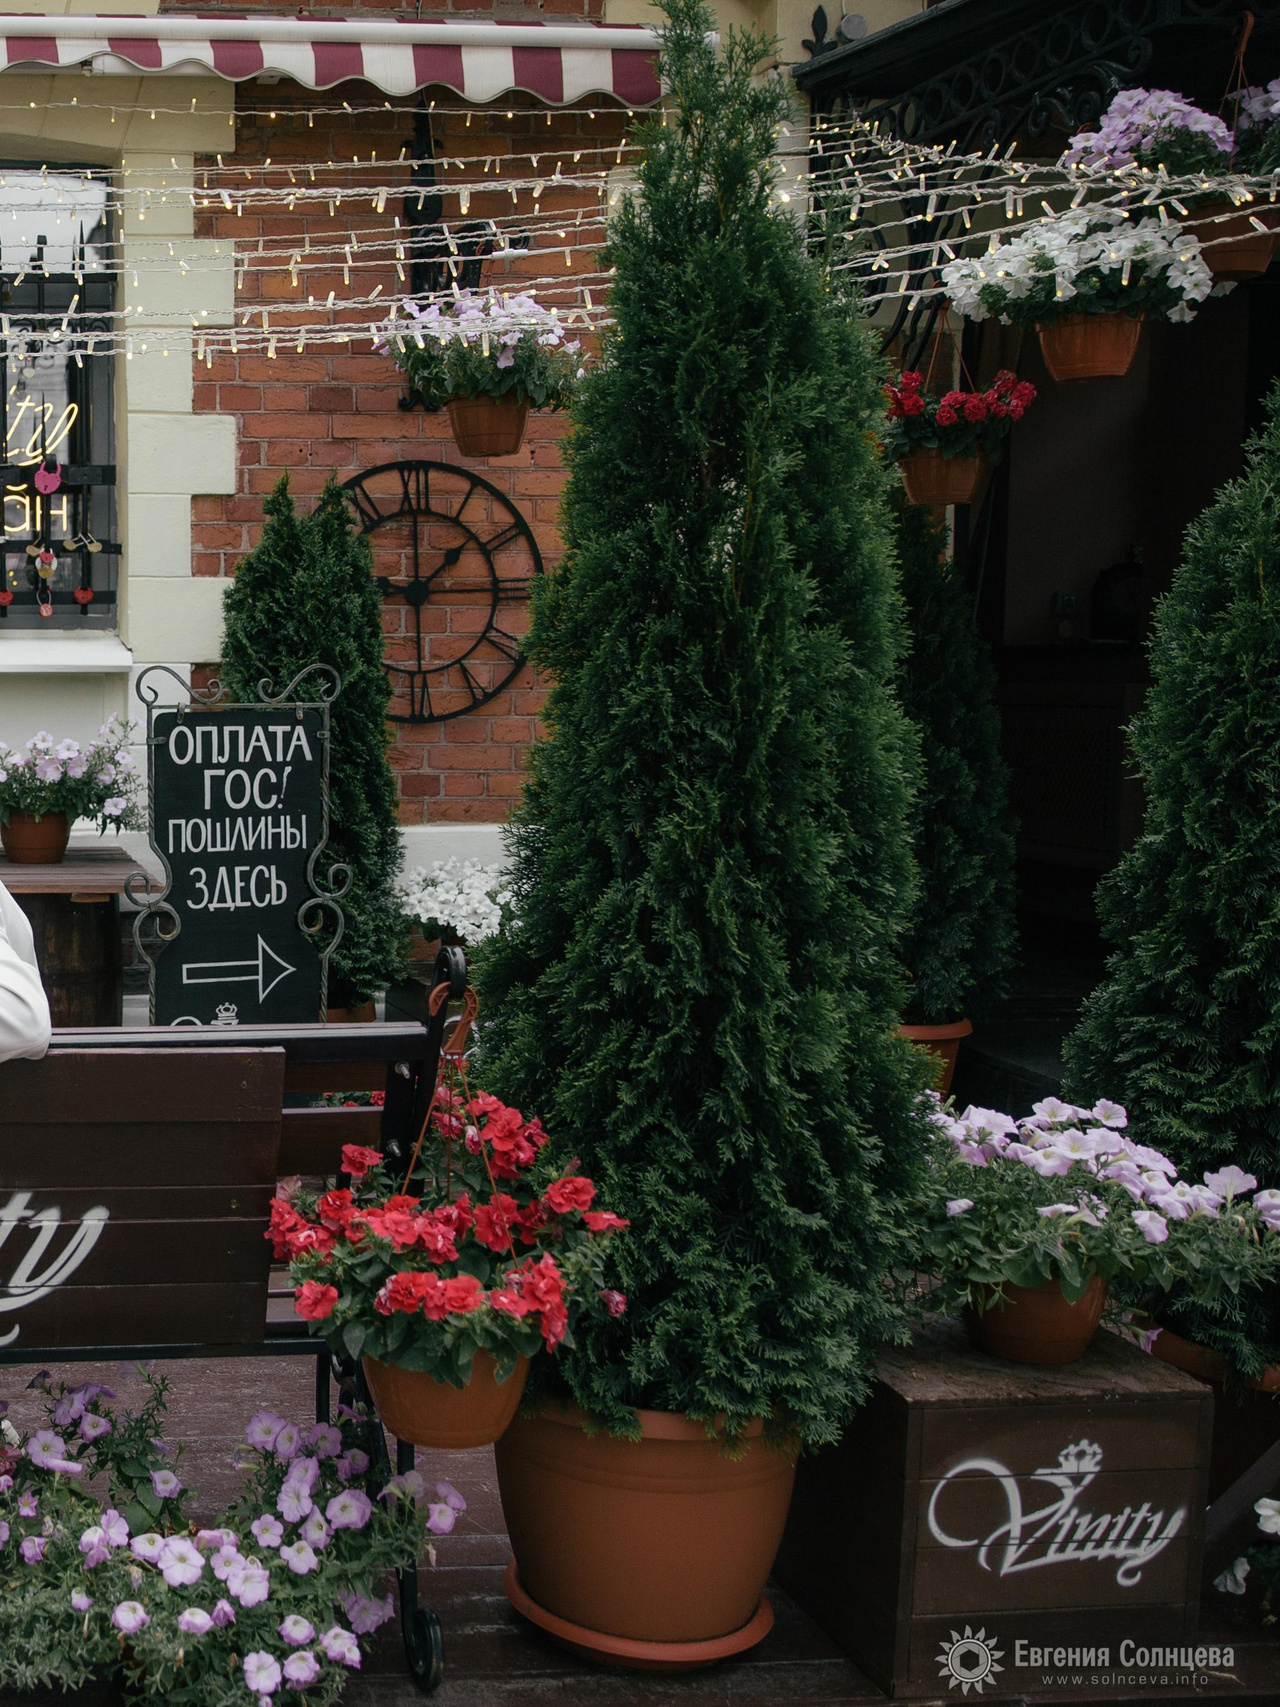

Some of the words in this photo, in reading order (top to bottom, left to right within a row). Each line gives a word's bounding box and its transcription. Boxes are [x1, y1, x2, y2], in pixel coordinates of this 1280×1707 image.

[169, 725, 313, 765] ОПЛАТА
[168, 814, 307, 854] ПОШЛИНЫ
[186, 865, 287, 912] ЗДЕСЬ
[927, 1456, 1188, 1586] Vinity
